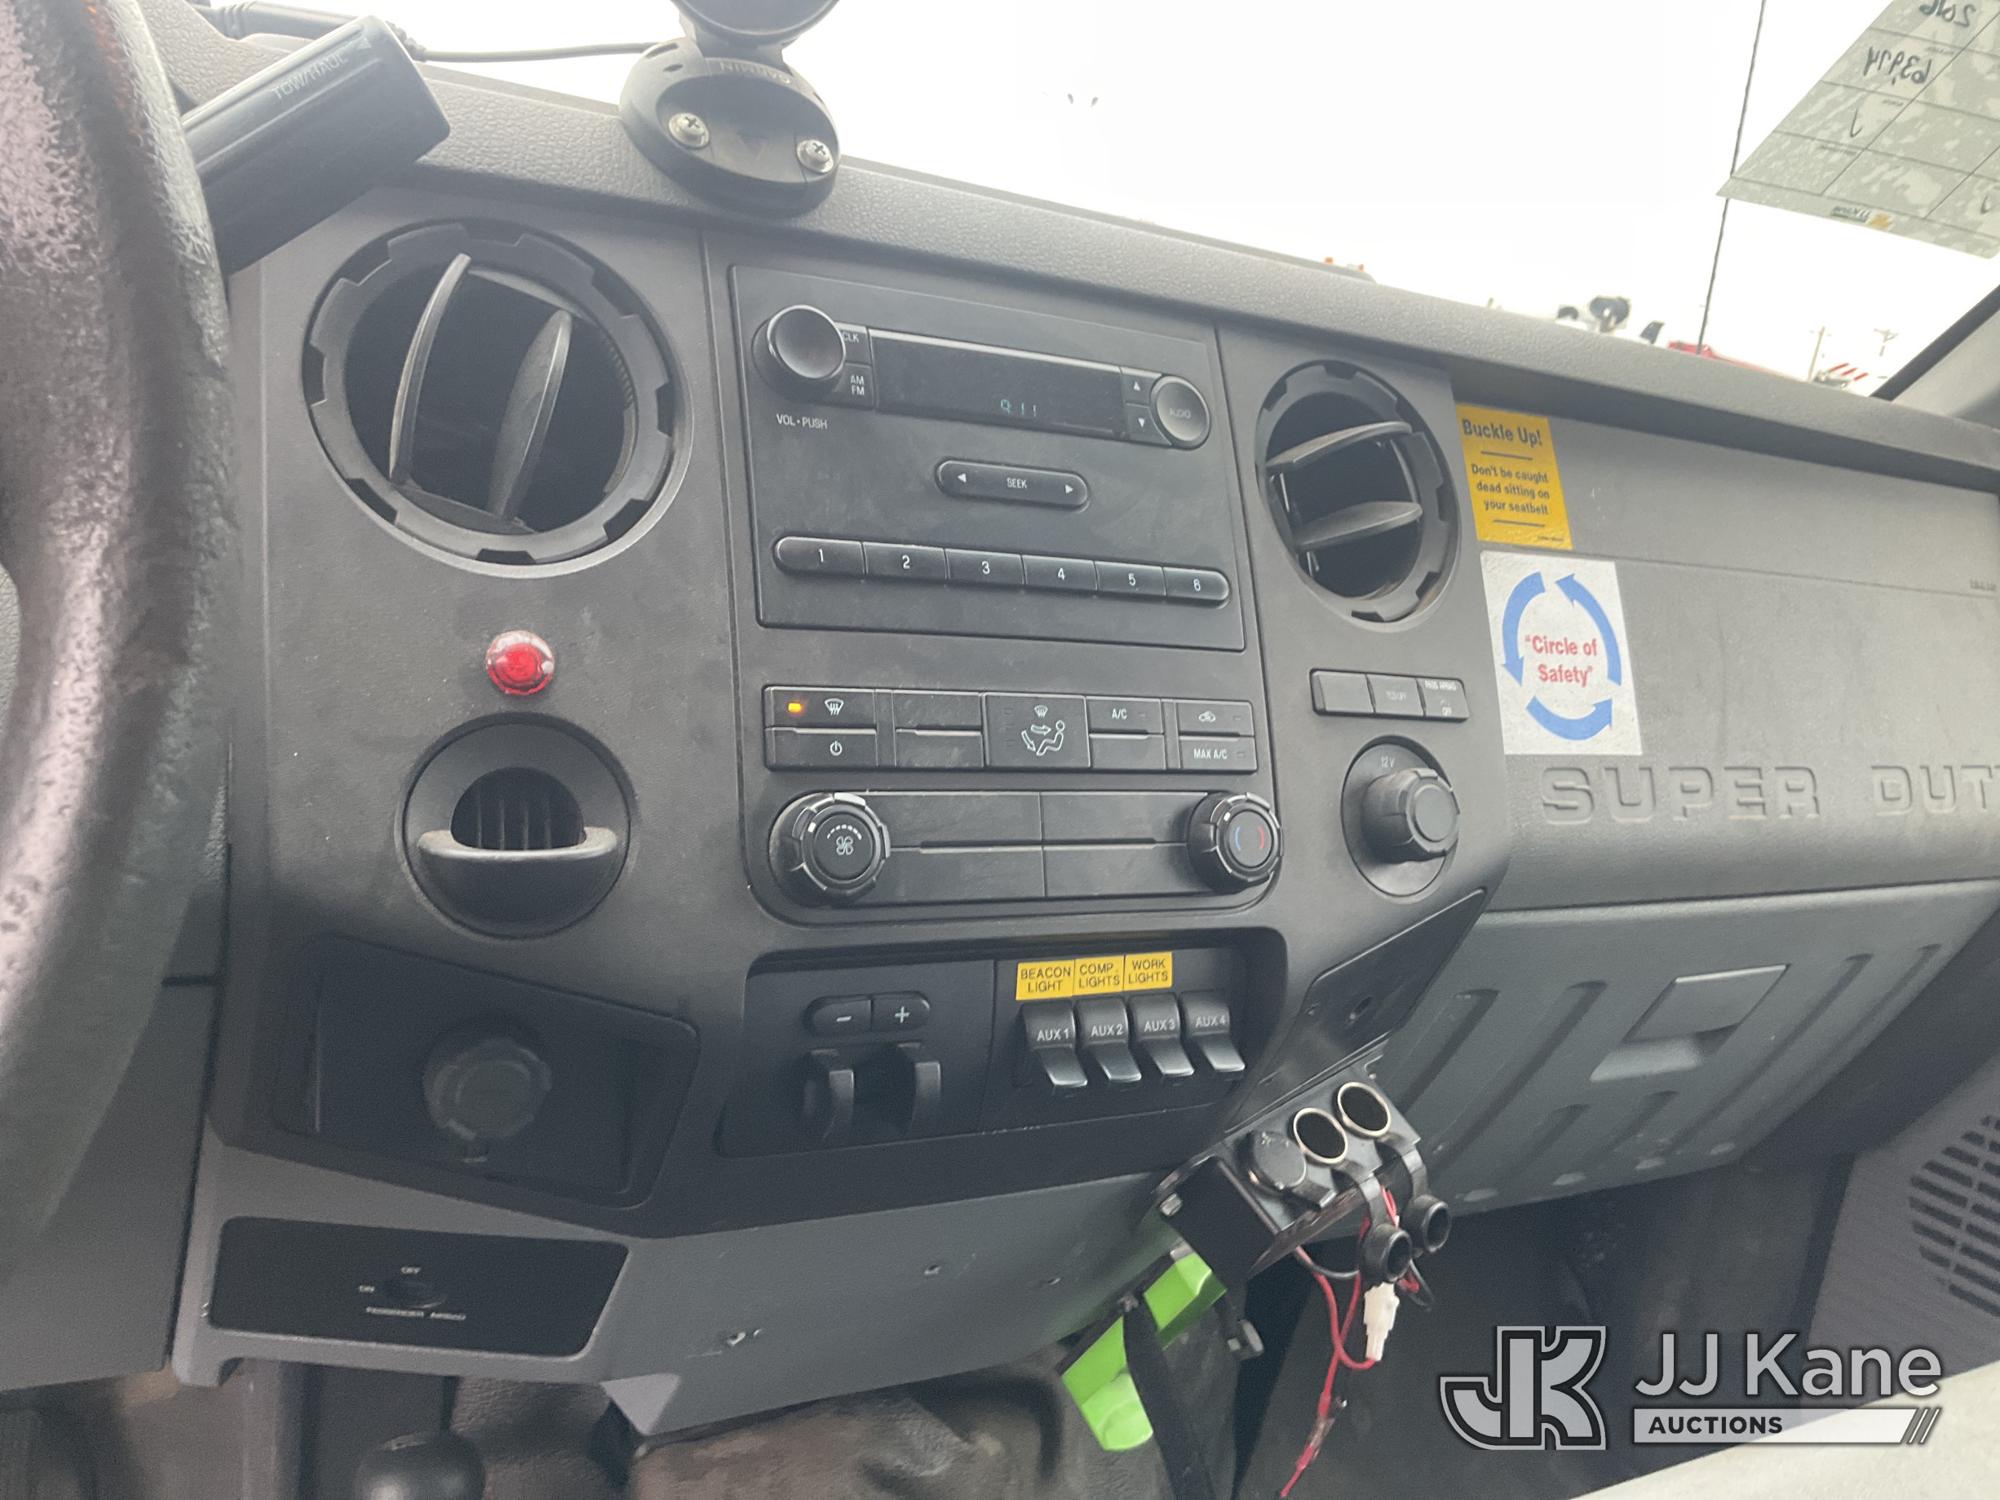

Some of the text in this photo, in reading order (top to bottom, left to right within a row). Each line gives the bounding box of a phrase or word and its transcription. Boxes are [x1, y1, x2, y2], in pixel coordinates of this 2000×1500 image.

[850, 374, 865, 385] AM
[851, 385, 865, 396] FM
[1462, 418, 1543, 447] Buckle Up!
[1471, 463, 1549, 484] Don't be caught
[1006, 477, 1028, 489] SEEK
[1477, 480, 1550, 500] dead sitting on
[1484, 500, 1506, 511] your
[818, 549, 824, 563] 1
[902, 554, 910, 569] 2
[981, 560, 990, 575] 3
[1057, 567, 1066, 581] 4
[1128, 572, 1136, 586] 5
[1193, 578, 1201, 592] 6
[1583, 638, 1598, 657] of
[1111, 708, 1128, 720] A/C
[1193, 748, 1228, 760] MAX A/C
[1541, 764, 2000, 825] SUPER DUT
[1131, 957, 1166, 971] WORK
[1020, 966, 1072, 980] BEACON
[1128, 971, 1169, 985] LIGHTS
[1027, 980, 1064, 993] LIGHT
[1078, 975, 1120, 989] LIGHTS
